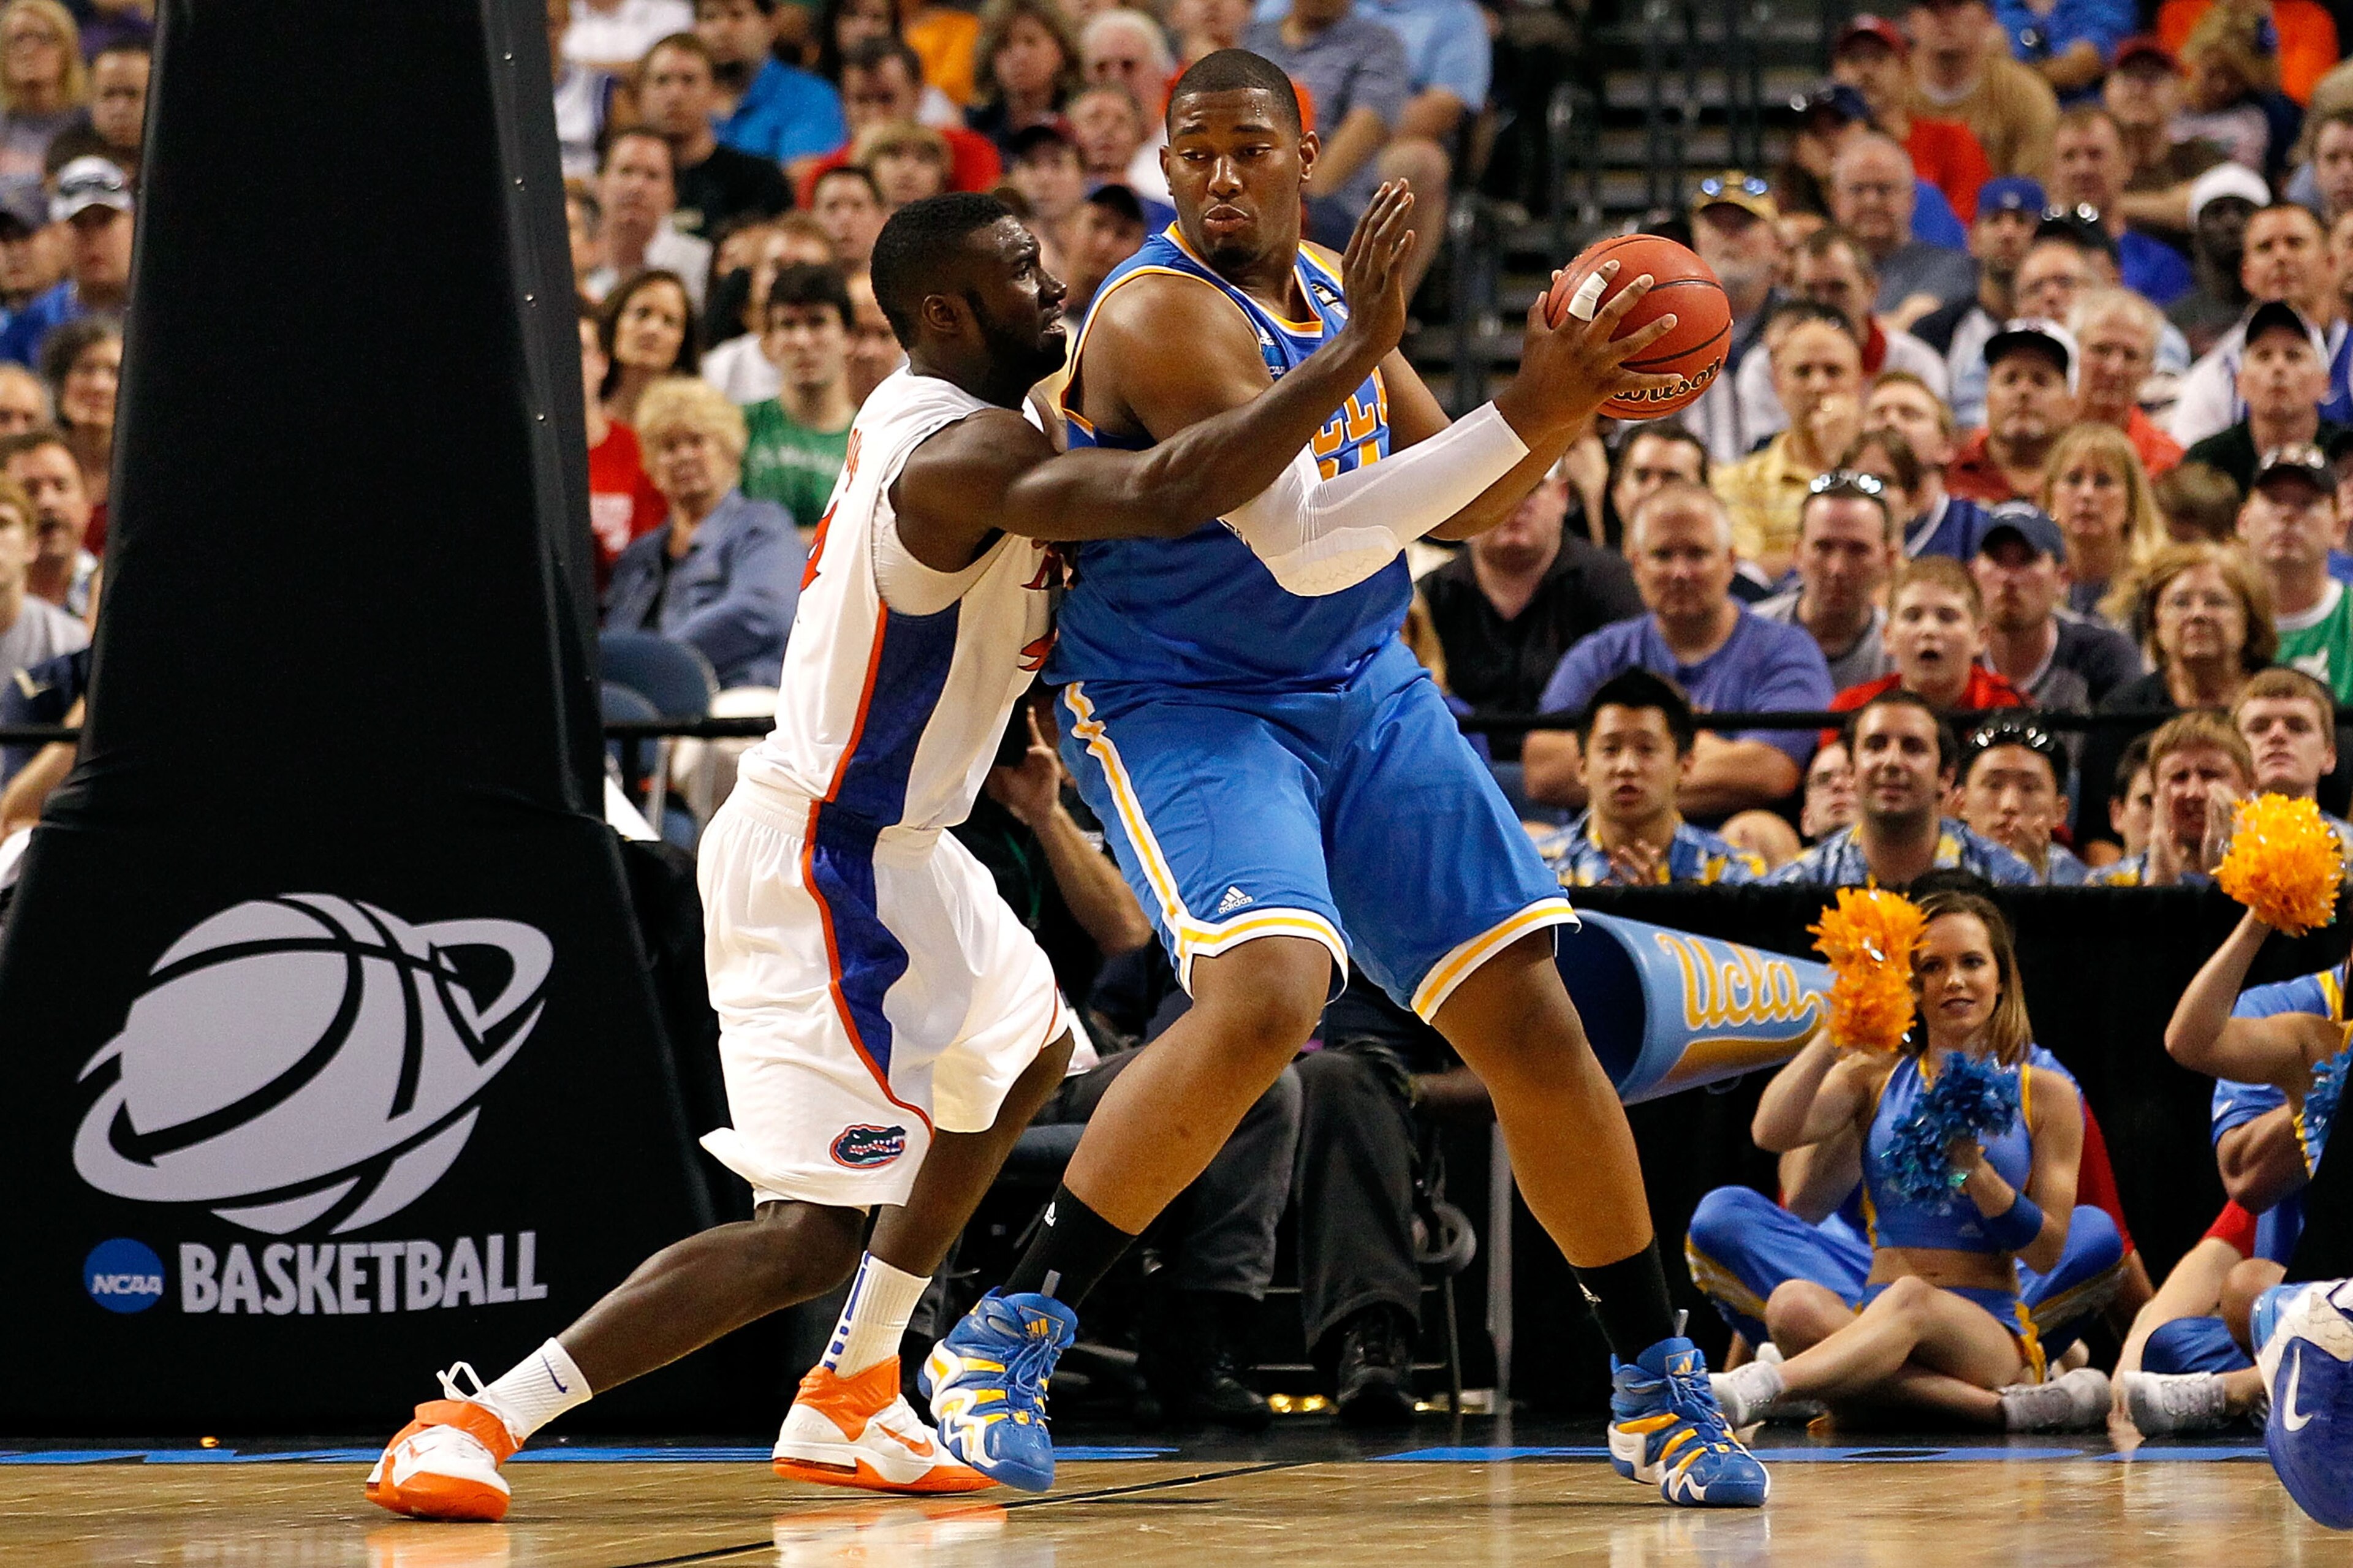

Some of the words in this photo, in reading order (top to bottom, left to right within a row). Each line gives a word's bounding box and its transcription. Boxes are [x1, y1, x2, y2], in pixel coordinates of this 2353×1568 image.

[1218, 895, 1254, 914] adidas
[91, 1274, 164, 1296] NCAA
[178, 1232, 548, 1316] BASKETBALL
